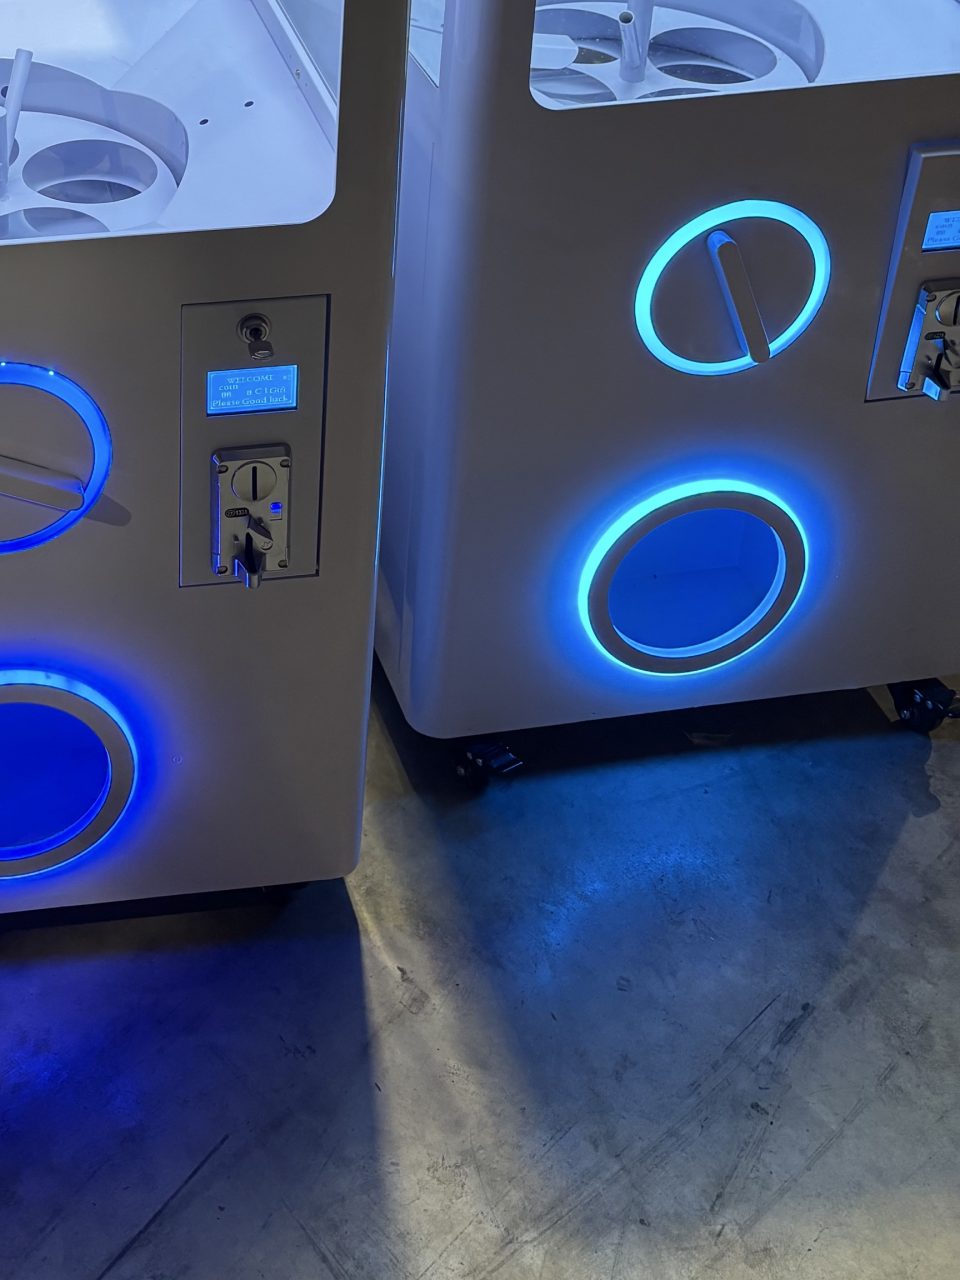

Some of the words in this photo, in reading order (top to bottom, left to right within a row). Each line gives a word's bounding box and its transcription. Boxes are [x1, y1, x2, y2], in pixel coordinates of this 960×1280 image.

[227, 374, 273, 384] WELCOME
[212, 399, 240, 407] Please
[241, 396, 267, 405] Good
